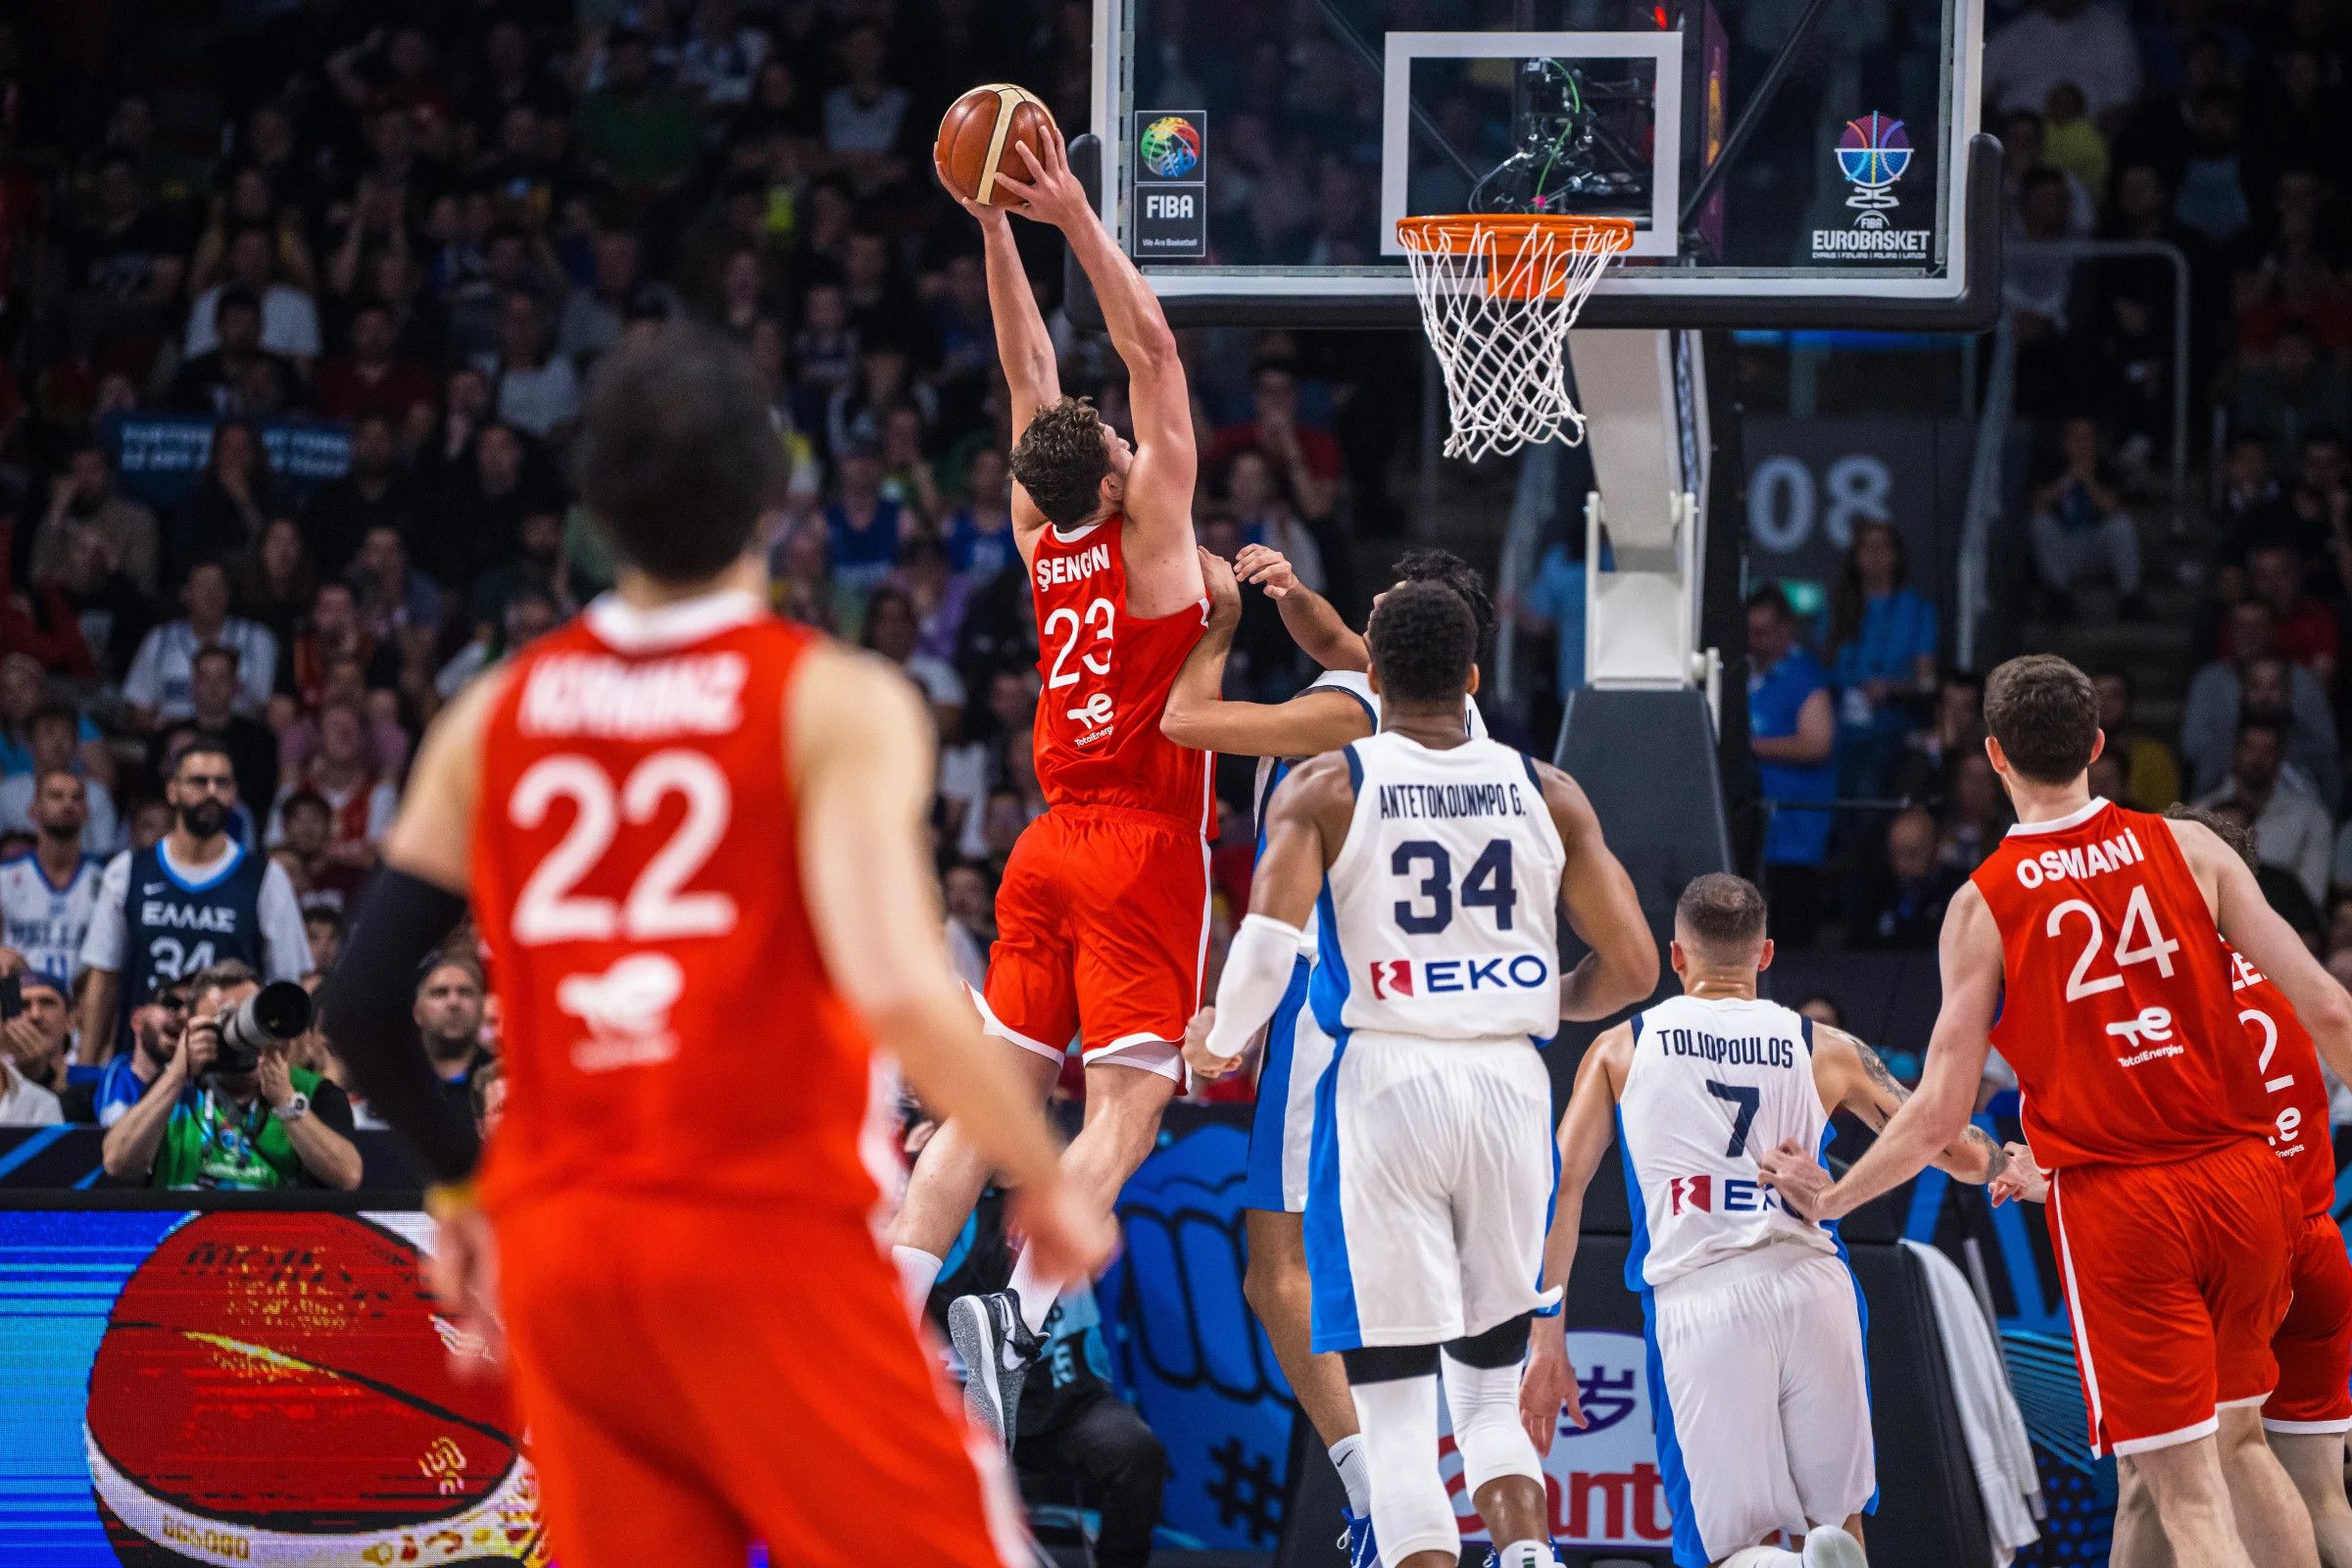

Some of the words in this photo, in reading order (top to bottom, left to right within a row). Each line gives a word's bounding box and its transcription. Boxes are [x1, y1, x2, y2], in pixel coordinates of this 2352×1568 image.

[1147, 195, 1194, 219] FIBA
[1861, 218, 1882, 229] FIBA
[1812, 229, 1930, 251] EUROBASKET
[1747, 455, 1892, 553] 08
[1044, 597, 1115, 690] 23
[1380, 784, 1506, 820] ANTETOKOUNMPO
[1510, 783, 1527, 816] G.
[509, 748, 739, 947] 22
[2017, 827, 2145, 889] OSMANİ
[1392, 838, 1517, 935] 34
[2046, 884, 2180, 1004] 24
[1425, 955, 1547, 993] EKO
[1656, 1029, 1793, 1069] TOLIOPOULOS
[2118, 1044, 2184, 1067] TotalEnergies
[1705, 1079, 1760, 1157] 7
[2275, 1144, 2305, 1159] Energies
[1724, 1179, 1804, 1220] EK
